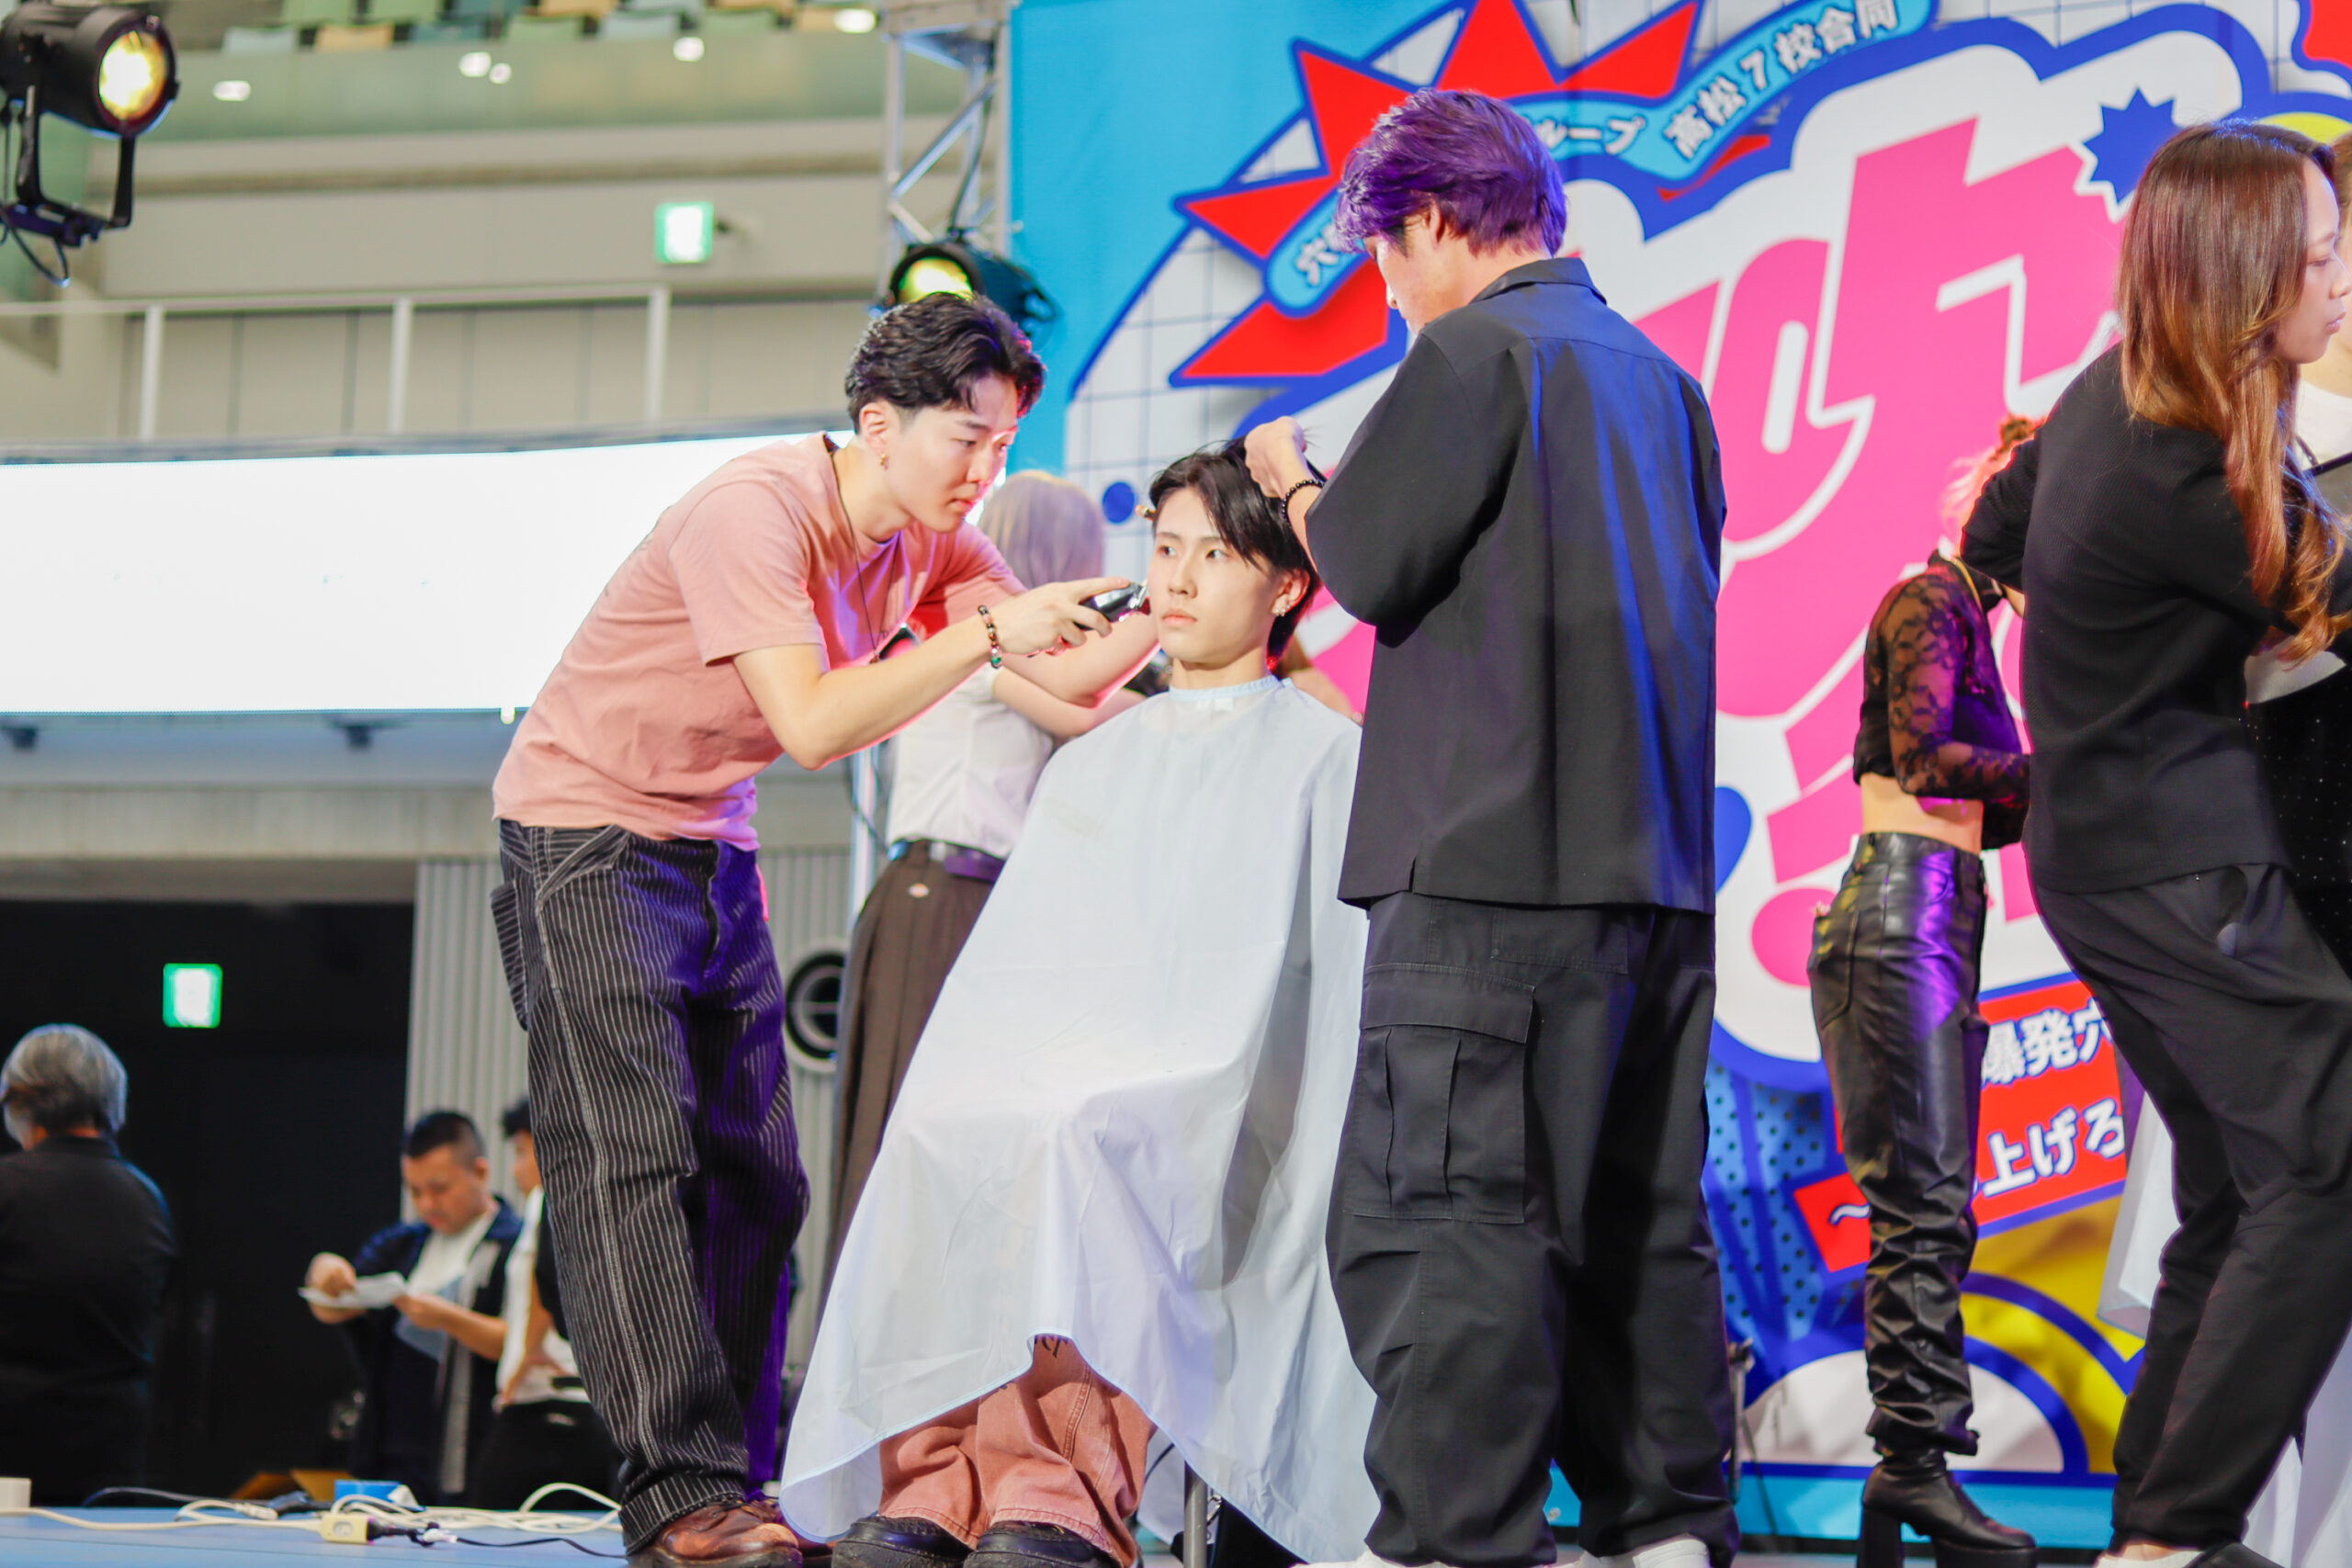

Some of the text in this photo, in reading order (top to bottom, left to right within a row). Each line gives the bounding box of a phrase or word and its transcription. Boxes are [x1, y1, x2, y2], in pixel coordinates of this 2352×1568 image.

[1521, 113, 1645, 155] ループ
[1974, 1098, 2126, 1198] 上げろ
